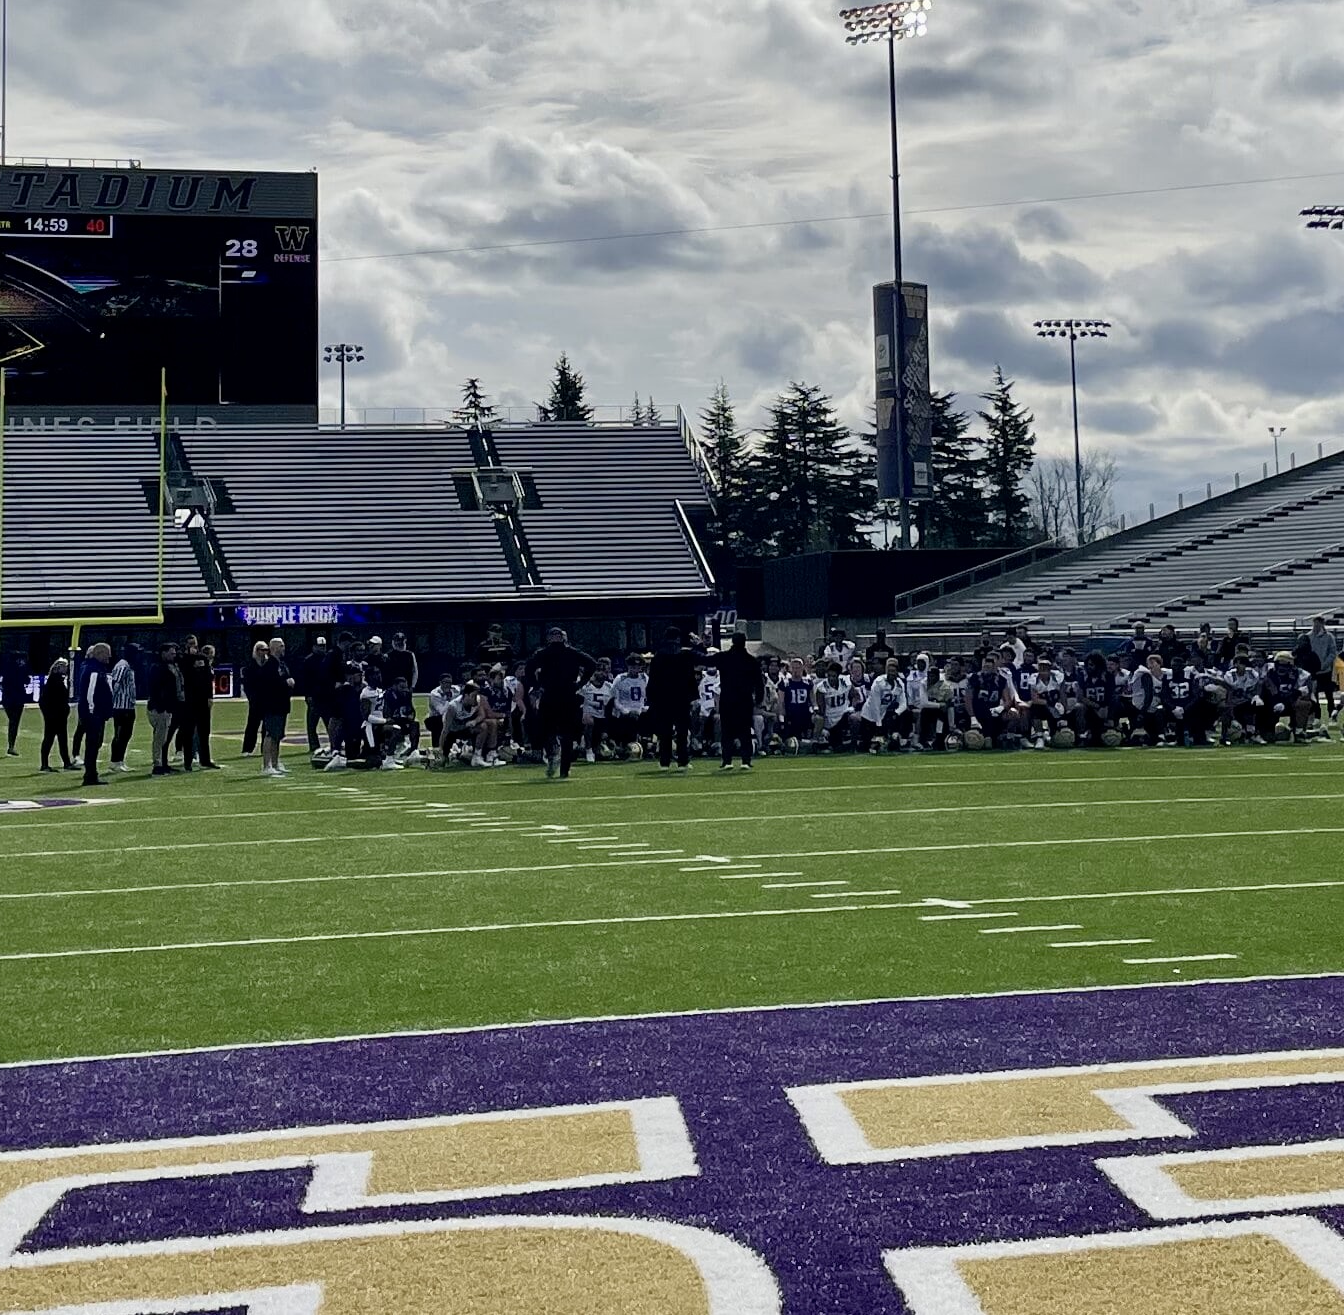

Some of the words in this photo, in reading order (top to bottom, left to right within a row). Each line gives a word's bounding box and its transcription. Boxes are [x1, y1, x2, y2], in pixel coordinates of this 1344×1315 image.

[24, 219, 68, 231] 14:59
[86, 220, 104, 231] 40
[225, 240, 257, 257] 28
[274, 254, 310, 263] DEFENSE
[250, 606, 296, 624] PURPLE
